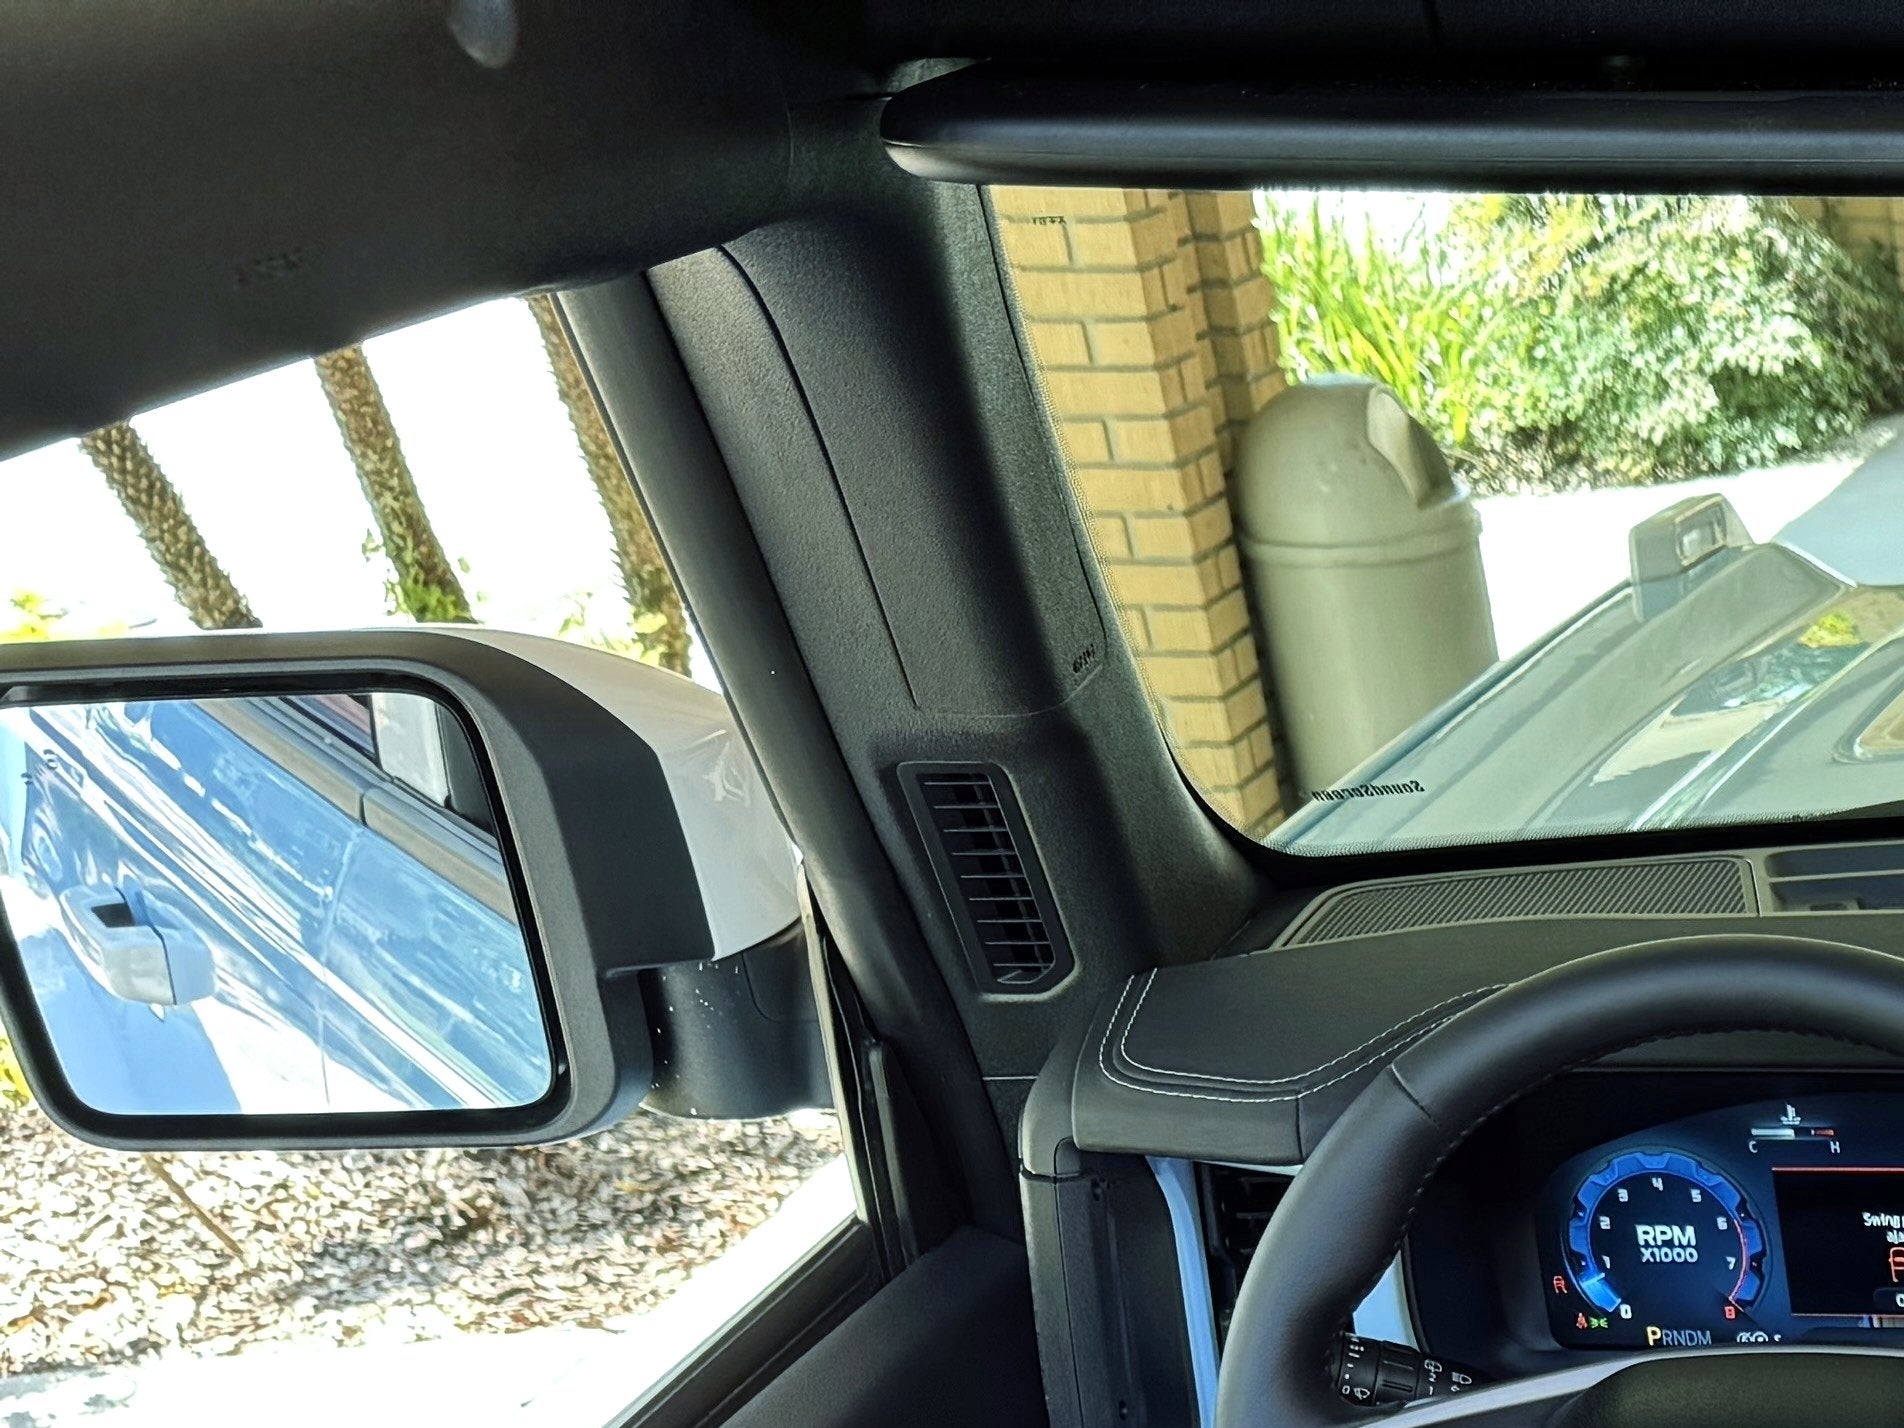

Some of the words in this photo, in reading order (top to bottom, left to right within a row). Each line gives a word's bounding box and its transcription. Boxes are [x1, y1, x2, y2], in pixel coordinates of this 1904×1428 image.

[1748, 1141, 1758, 1153] C
[1830, 1141, 1841, 1153] H
[1652, 1177, 1664, 1191] 4
[1617, 1188, 1628, 1202] 3
[1691, 1189, 1702, 1203] 5
[1600, 1216, 1611, 1230] 2
[1717, 1216, 1727, 1230] 6
[1862, 1212, 1900, 1229] Swing
[1636, 1225, 1696, 1246] RPM
[1603, 1255, 1611, 1269] 1
[1641, 1247, 1698, 1263] X1000
[1726, 1257, 1737, 1270] 7
[1620, 1304, 1632, 1319] 0
